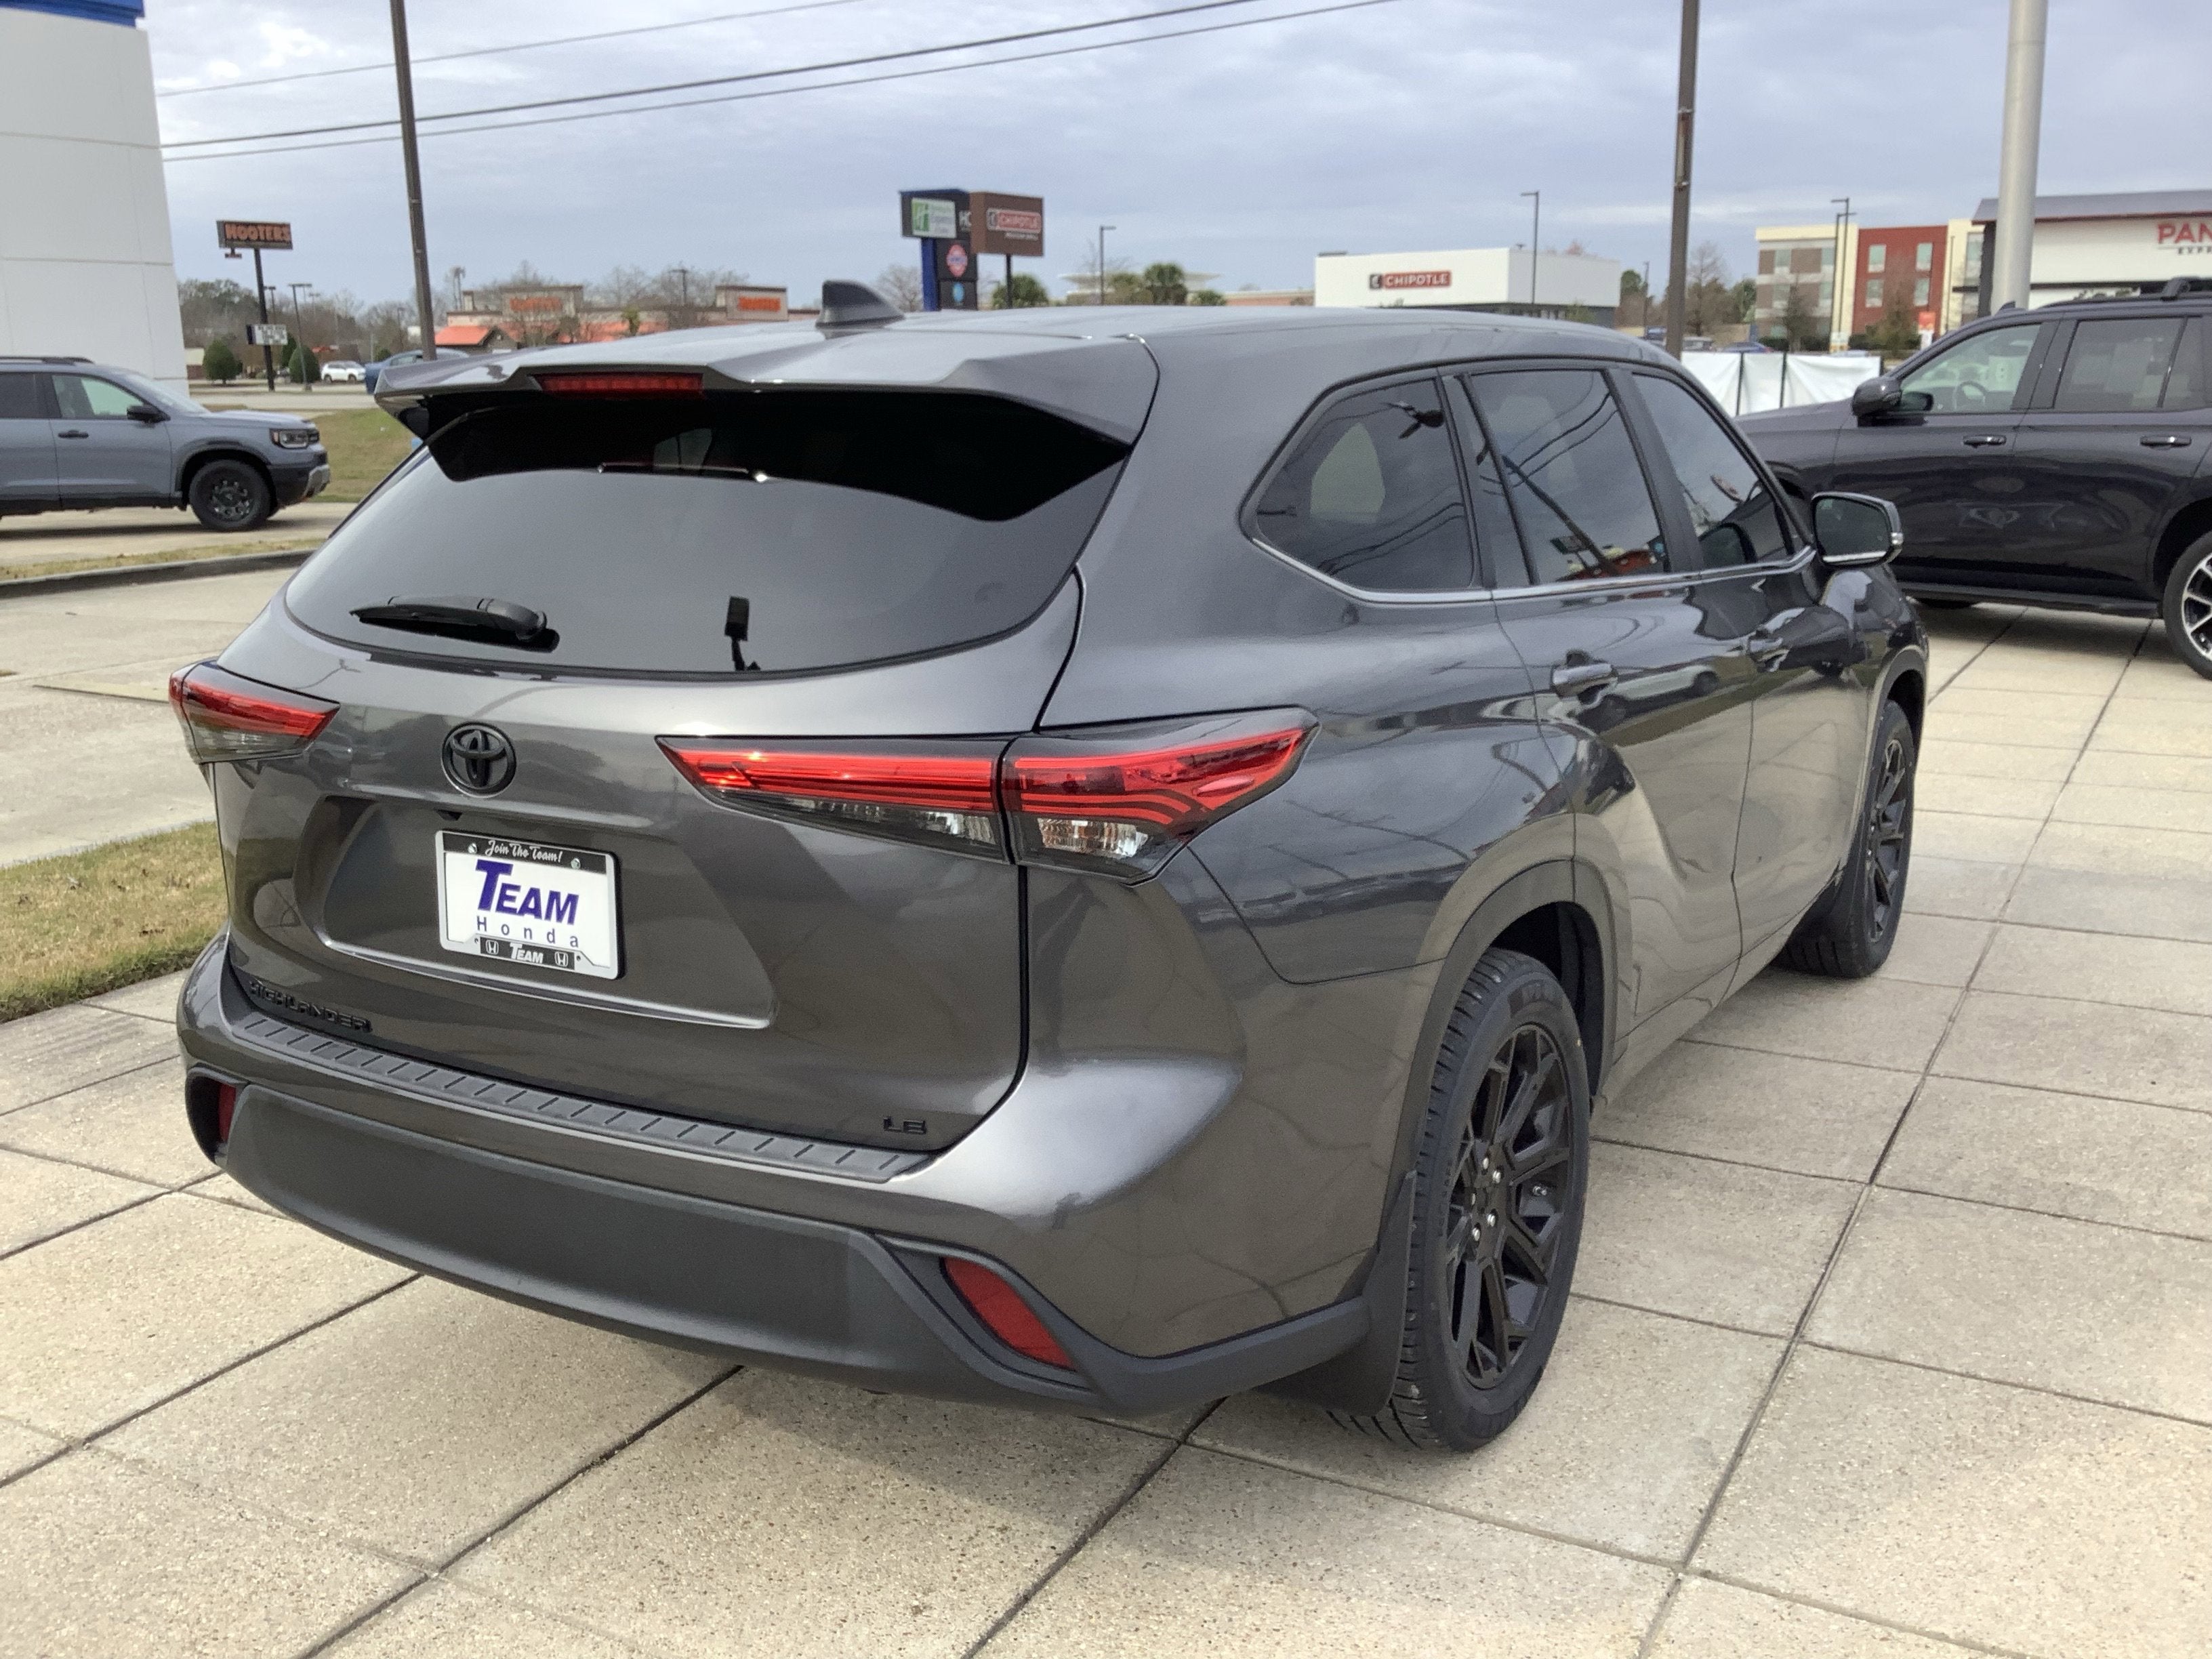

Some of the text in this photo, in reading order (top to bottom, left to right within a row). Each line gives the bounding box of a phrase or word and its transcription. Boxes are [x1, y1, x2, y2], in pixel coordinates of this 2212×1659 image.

[224, 224, 290, 242] HOOTERS
[1385, 271, 1450, 288] CHIPOTLE
[485, 840, 563, 863] Join The Team!
[475, 859, 579, 926] TEAM
[476, 916, 579, 948] Honda
[509, 942, 544, 964] TEAM
[248, 977, 373, 1033] HIGHLANDER
[883, 1115, 926, 1134] LE
